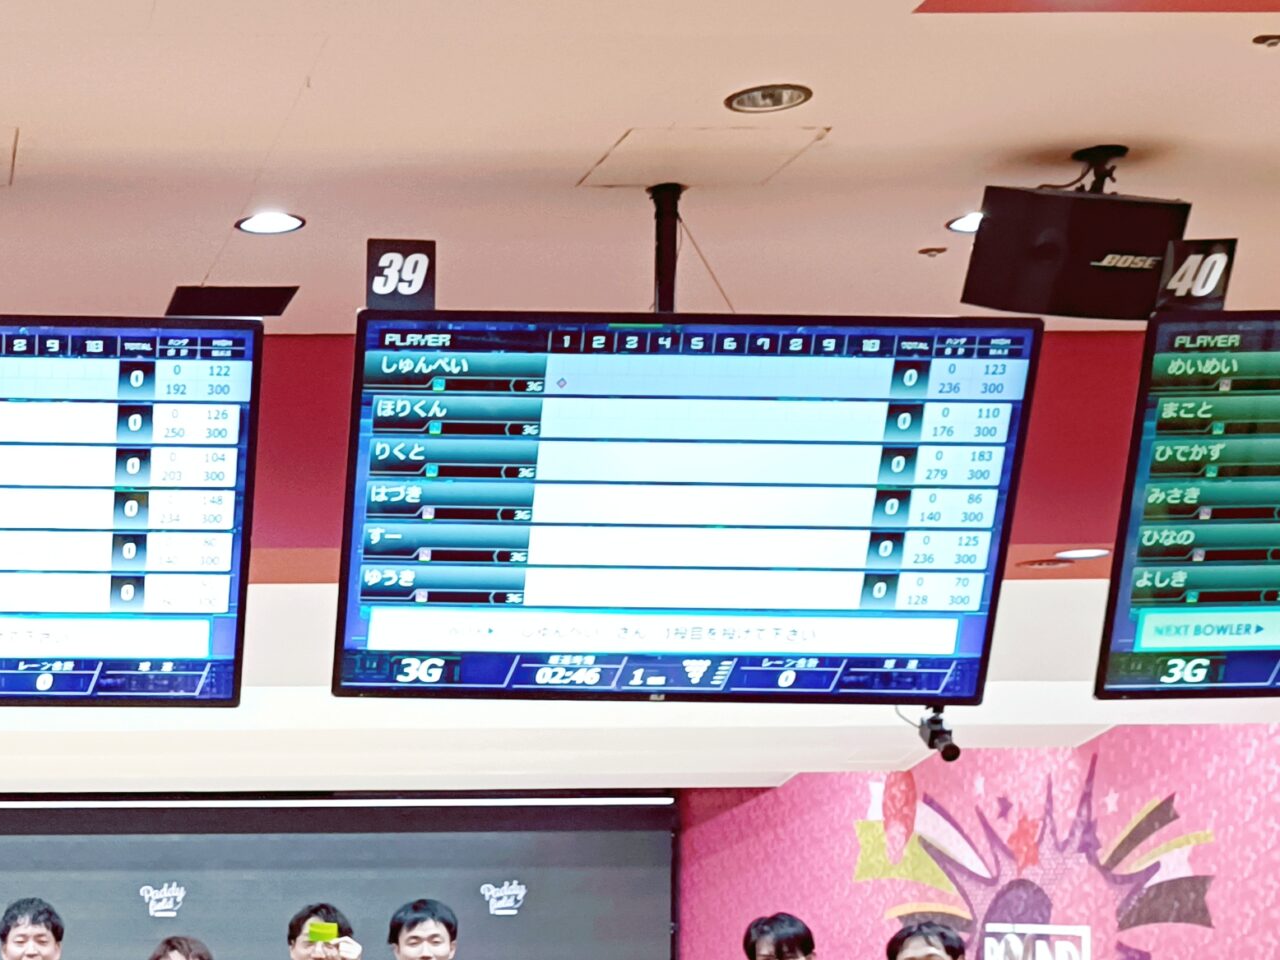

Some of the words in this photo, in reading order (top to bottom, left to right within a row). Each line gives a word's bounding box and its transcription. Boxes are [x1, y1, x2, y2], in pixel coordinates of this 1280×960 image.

[1090, 254, 1162, 269] BOSE
[372, 252, 429, 295] 39
[1166, 252, 1228, 297] 40
[124, 342, 152, 352] TOTAL
[384, 334, 452, 347] PLAYER
[562, 335, 571, 348] 1
[592, 336, 606, 348] 2
[625, 336, 638, 349] 3
[658, 336, 671, 349] 4
[691, 337, 704, 349] 5
[723, 338, 737, 350] 6
[822, 338, 836, 351] 9
[1175, 334, 1240, 348] PLAYER
[208, 365, 230, 377] 122
[381, 356, 468, 374] しゅんぺい
[984, 364, 1006, 375] 123
[1167, 358, 1238, 375] めいめい
[165, 383, 187, 395] 192
[207, 384, 230, 395] 300
[526, 381, 543, 392] 3G
[938, 383, 960, 394] 236
[981, 383, 1004, 394] 300
[377, 399, 447, 418] ほりくん
[977, 407, 1000, 418] 110
[1161, 402, 1213, 419] まこと
[206, 427, 227, 439] 300
[522, 424, 539, 435] 3G
[932, 426, 954, 437] 176
[974, 426, 997, 437] 300
[375, 442, 425, 460] りくと
[970, 451, 993, 462] 183
[1155, 443, 1226, 461] ひでかず
[518, 468, 534, 478] 3G
[926, 469, 948, 480] 279
[967, 469, 990, 480] 300
[371, 485, 422, 503] はづき
[967, 494, 982, 504] 86
[1147, 487, 1200, 504] みさき
[514, 510, 531, 520] 3G
[920, 511, 941, 522] 140
[961, 511, 984, 522] 300
[368, 527, 402, 545] すー
[958, 536, 979, 547] 125
[1142, 530, 1195, 546] ひなの
[510, 552, 526, 562] 3G
[913, 553, 934, 564] 236
[954, 553, 977, 564] 300
[364, 569, 416, 587] ゆうき
[955, 577, 969, 587] 70
[1135, 571, 1188, 588] よしき
[506, 594, 522, 604] 3G
[907, 595, 928, 606] 128
[948, 595, 970, 606] 300
[1154, 625, 1189, 636] NEXT
[1193, 624, 1252, 636] BOWLER
[396, 658, 445, 683] 3G
[535, 667, 601, 685] 02:46
[1160, 659, 1210, 683] 3G
